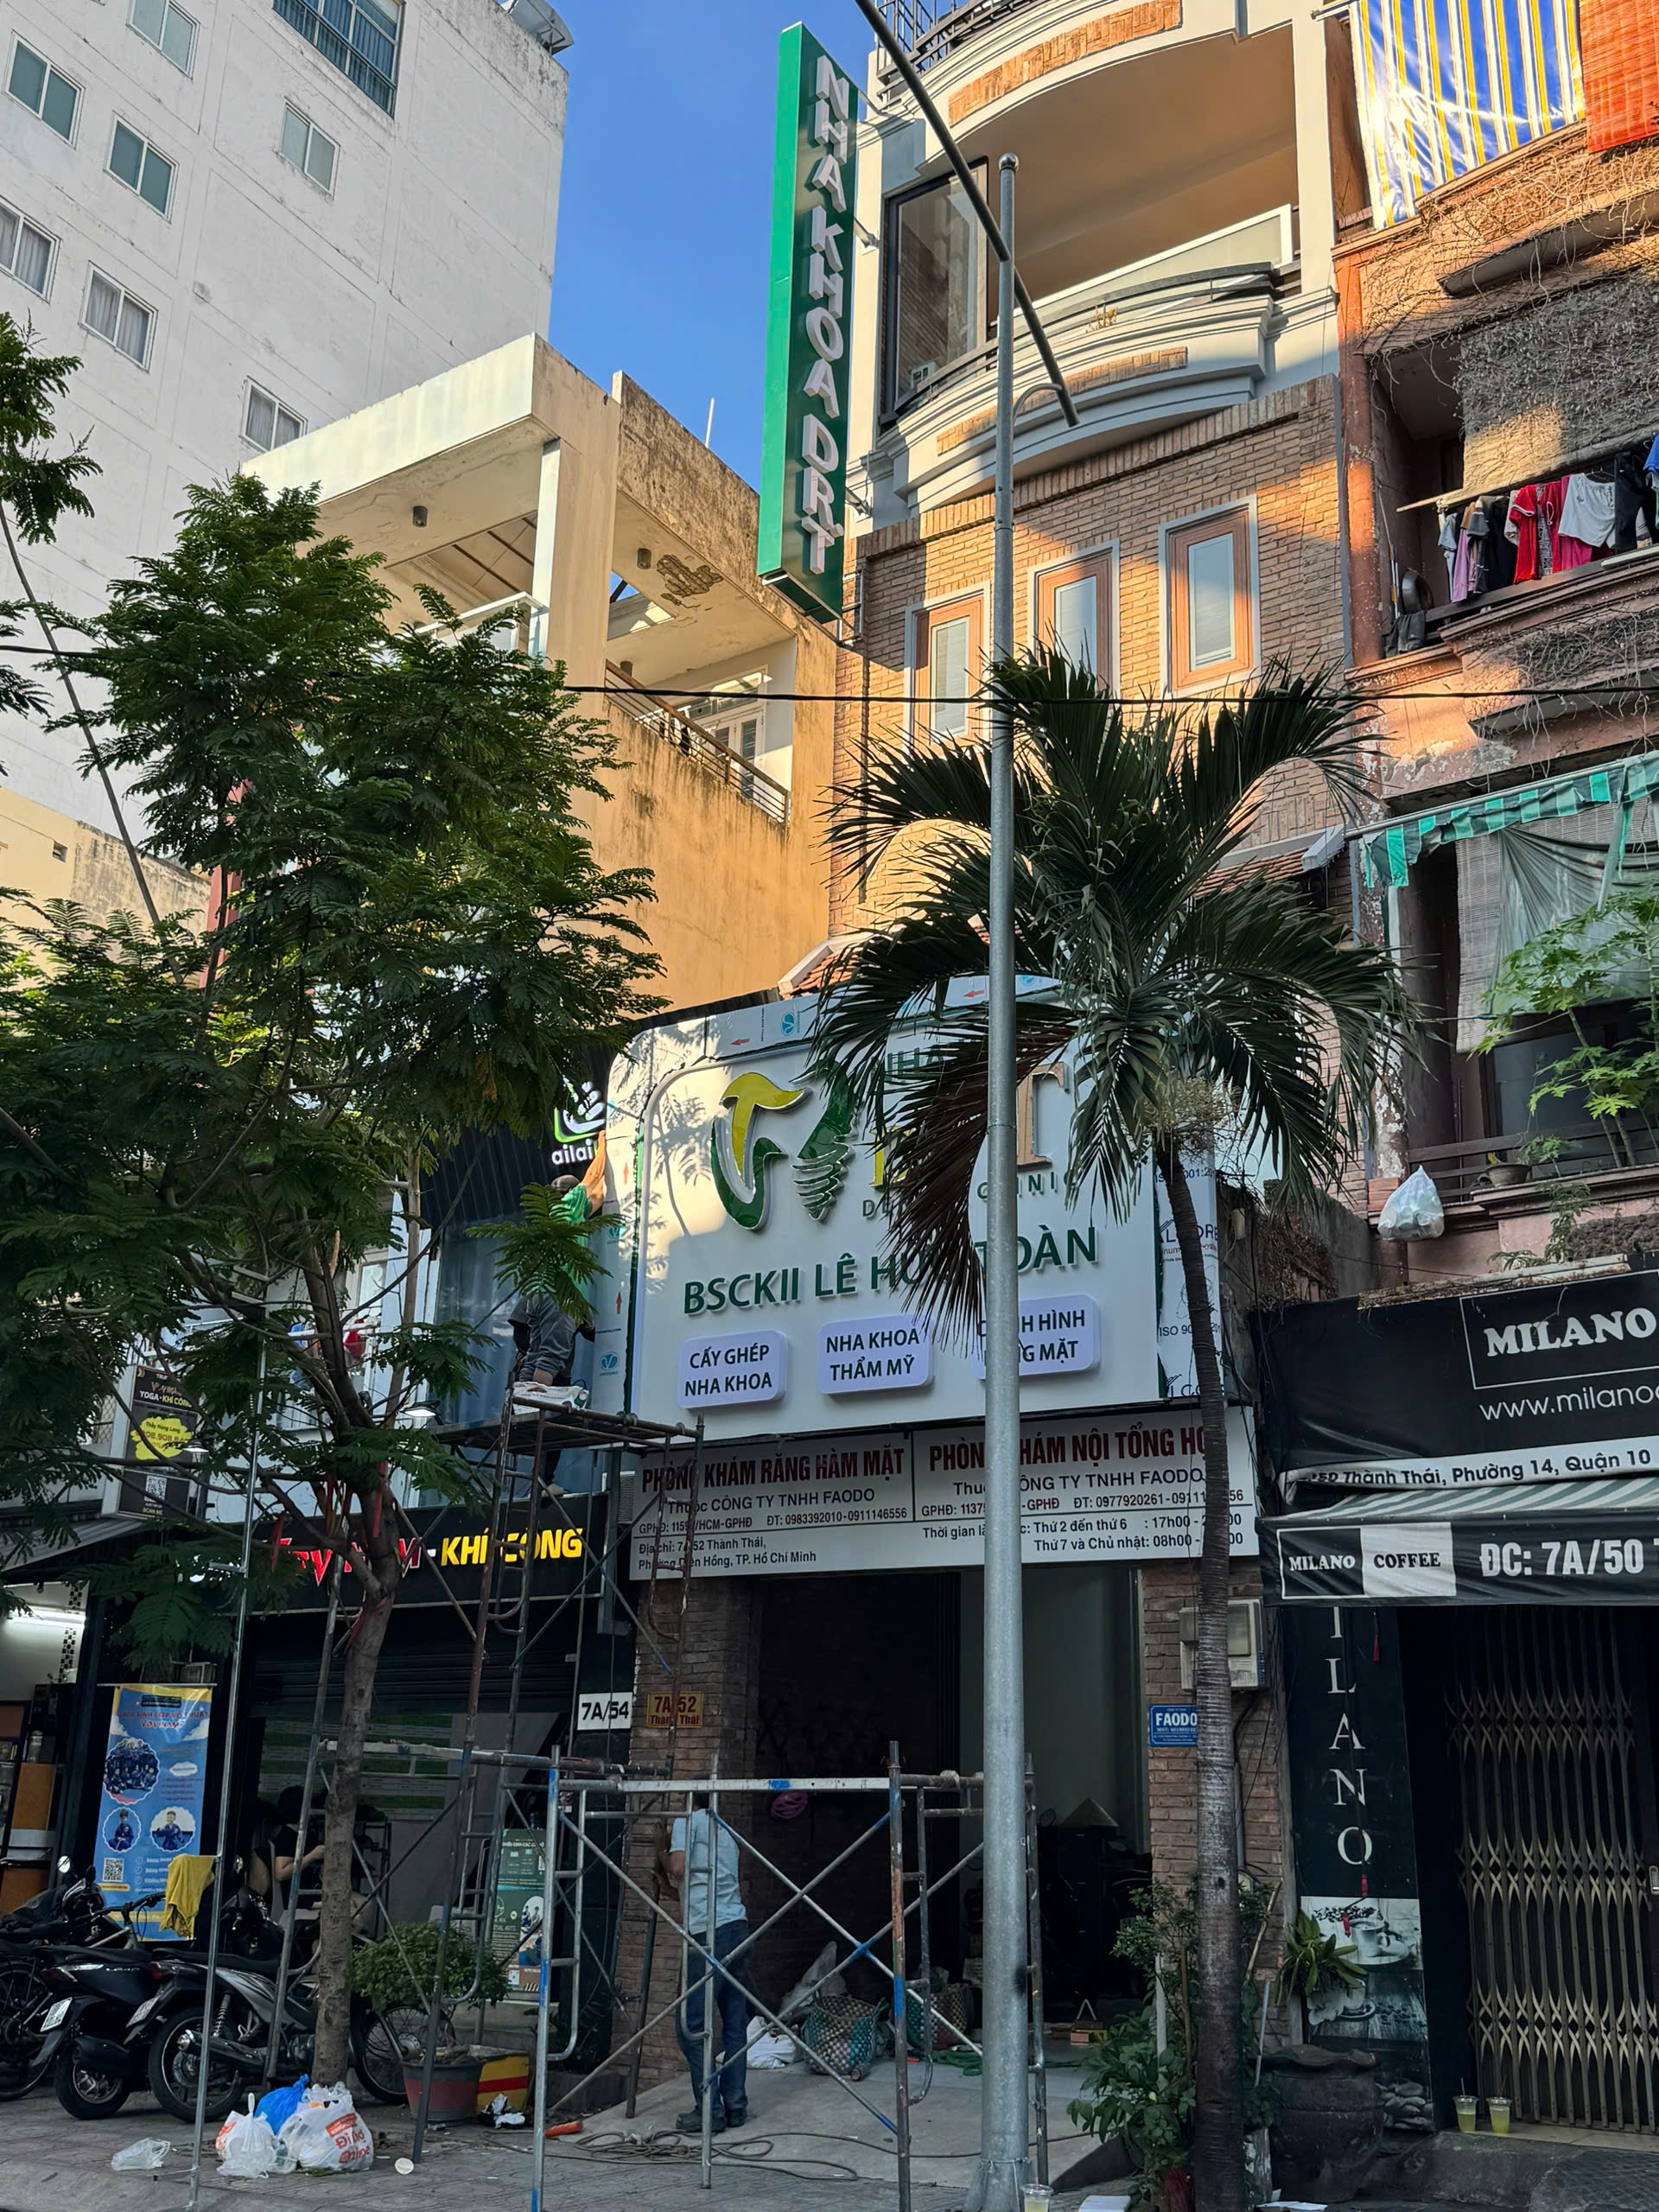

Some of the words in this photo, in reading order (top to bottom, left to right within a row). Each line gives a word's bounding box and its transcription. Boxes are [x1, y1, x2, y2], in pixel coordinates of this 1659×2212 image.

[551, 1138, 598, 1166] ailai
[683, 1268, 800, 1315] BSCKII
[815, 1253, 858, 1298] LÊ
[1039, 1309, 1085, 1332] HÌNH
[1484, 1307, 1656, 1357] MILANO
[825, 1333, 864, 1354] NHA
[868, 1328, 920, 1350] KHOA
[1039, 1338, 1079, 1363] MẶT
[690, 1345, 721, 1369] CẤY
[724, 1342, 770, 1365] GHÉP
[830, 1356, 882, 1382] THẨM
[886, 1353, 915, 1376] MỸ
[139, 1390, 159, 1402] YOGA
[684, 1377, 721, 1397] NHA
[724, 1371, 772, 1393] KHOA
[930, 1436, 985, 1471] PHÒN
[1020, 1431, 1066, 1465] HÁM
[1071, 1427, 1109, 1467] NỘI
[1116, 1421, 1174, 1459] TỔNG
[642, 1459, 692, 1493] PHÒN
[703, 1457, 755, 1488] KHÁM
[760, 1452, 810, 1484] RĂNG
[816, 1447, 858, 1479] HÀM
[864, 1443, 905, 1481] MẶT
[1344, 1471, 1396, 1485] Thành
[1402, 1469, 1446, 1487] Thái,
[1452, 1462, 1524, 1483] Phường
[1530, 1459, 1559, 1478] 14,
[1565, 1452, 1620, 1472] Quận
[1627, 1449, 1651, 1466] 10
[954, 1482, 986, 1496] Thu
[1020, 1474, 1055, 1491] ÔNG
[1059, 1474, 1080, 1489] TY
[1085, 1471, 1135, 1488] TNHH
[1140, 1468, 1202, 1485] FAODO
[711, 1495, 753, 1511] CÔNG
[756, 1495, 774, 1508] TY
[779, 1492, 818, 1507] TNHH
[823, 1488, 875, 1503] FAODO
[921, 1504, 957, 1516] GPHĐ:
[1074, 1497, 1093, 1509] ĐT:
[671, 1516, 753, 1532] 1159/HCM-GPHĐ
[767, 1514, 783, 1526] ĐT:
[923, 1526, 948, 1539] Thời
[950, 1527, 976, 1541] gian
[1033, 1521, 1058, 1534] Thứ
[1059, 1522, 1067, 1533] 2
[1070, 1517, 1093, 1532] đến
[1096, 1517, 1118, 1531] thứ
[1120, 1518, 1128, 1529] 6
[1152, 1515, 1190, 1529] 17h00
[441, 1528, 487, 1566] KHÍ
[707, 1537, 739, 1550] Thành
[741, 1535, 766, 1548] Thái,
[1034, 1538, 1059, 1552] Thứ
[1061, 1539, 1068, 1550] 7
[1071, 1537, 1085, 1550] và
[1088, 1535, 1115, 1549] Chủ
[1117, 1535, 1150, 1550] nhật:
[1153, 1534, 1192, 1548] 08h00
[735, 1553, 751, 1565] TP.
[770, 1551, 788, 1563] Chí
[791, 1550, 817, 1562] Minh
[1289, 1554, 1356, 1572] MILANO
[1373, 1552, 1442, 1569] COFFEE
[1479, 1542, 1532, 1577] ĐC:
[1541, 1538, 1643, 1576] 7A/50
[581, 1701, 629, 1721] 7A/54
[654, 1696, 697, 1713] 7A52
[1155, 1713, 1198, 1726] FAODO
[1325, 1606, 1373, 1866] ILANO
